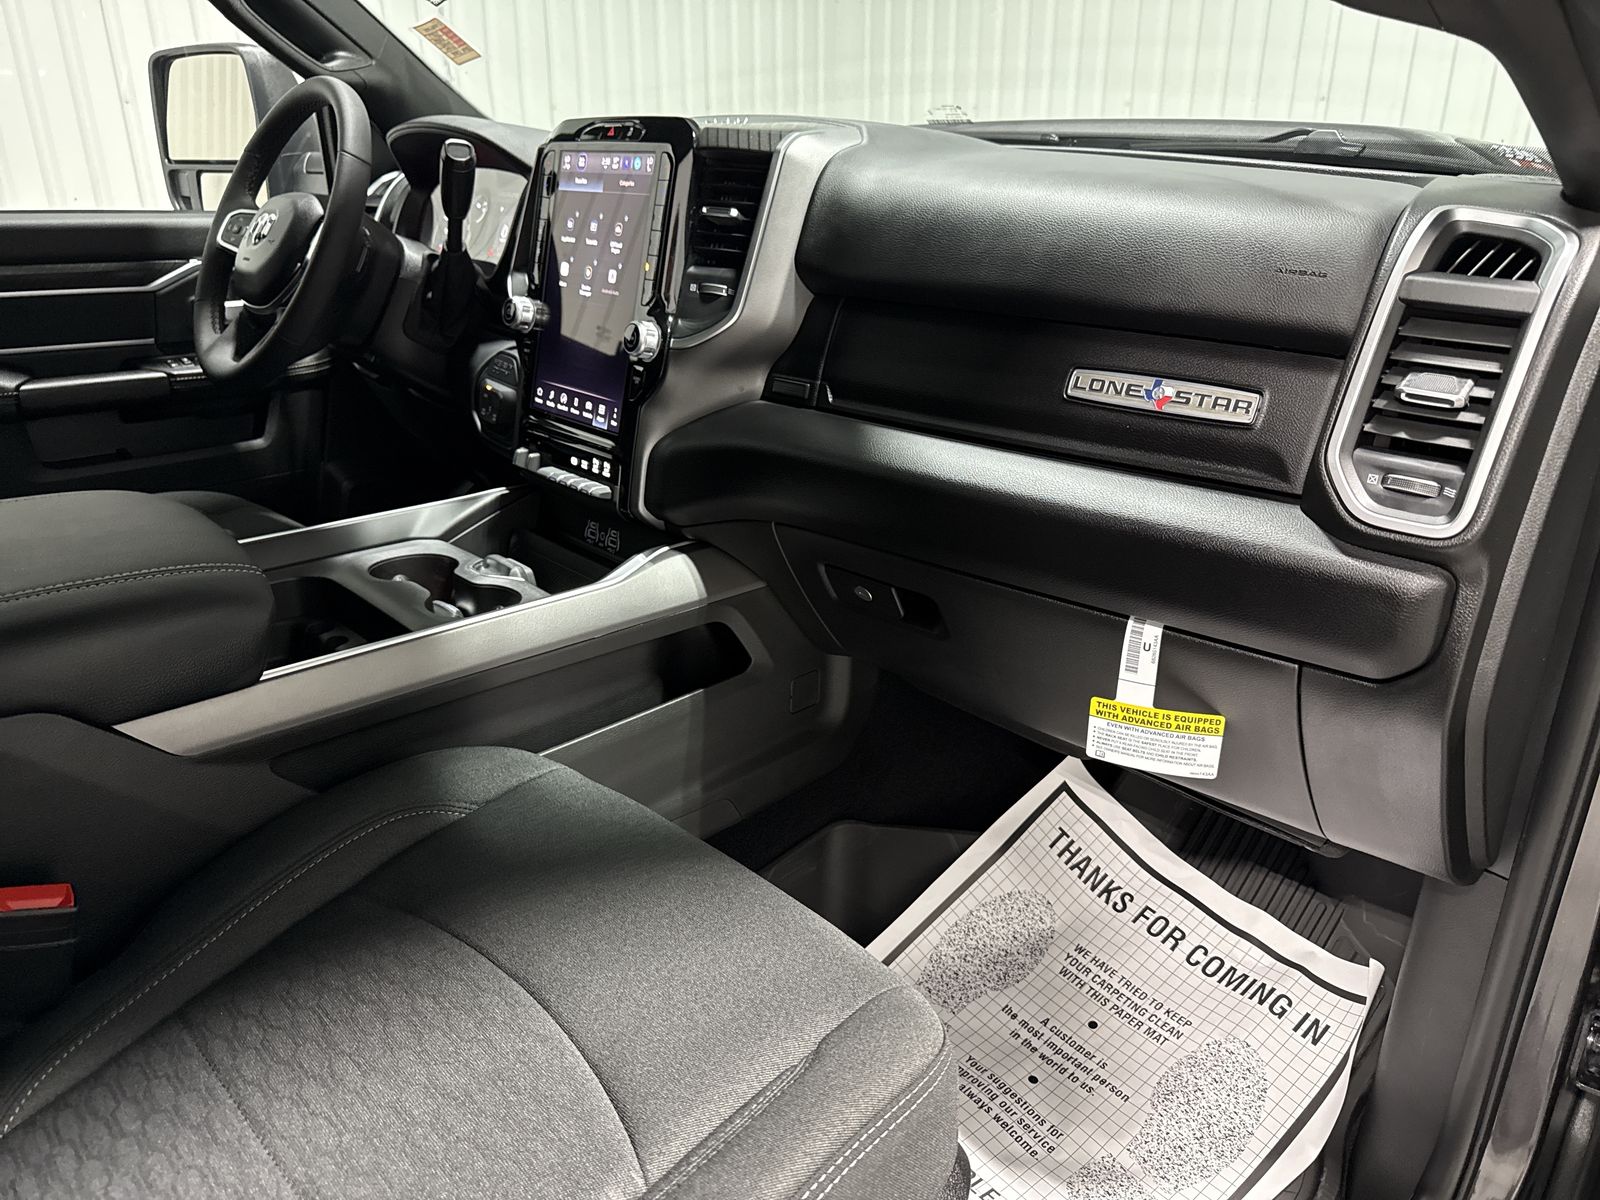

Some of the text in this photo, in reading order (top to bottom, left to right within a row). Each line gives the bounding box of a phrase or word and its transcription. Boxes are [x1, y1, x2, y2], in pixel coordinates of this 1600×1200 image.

[1275, 267, 1328, 279] AIRBAG
[1072, 375, 1253, 415] LONE STAR
[1143, 642, 1151, 651] U
[1095, 709, 1220, 734] WITH ADVANCED AIR BAGS
[1096, 701, 1221, 726] THIS VEHICLE IS EQUIPPED
[1107, 722, 1123, 730] EVEN
[1124, 725, 1139, 733] WITH
[1140, 728, 1174, 738] ADVANCED
[1187, 734, 1205, 742] BAGS
[1048, 827, 1331, 1047] THANKS FOR COMING IN
[1058, 966, 1170, 1047] WITH THIS PAPER MAT
[1063, 952, 1184, 1040] YOUR CARPETING CLEAN
[1073, 943, 1193, 1029] WE HAVE TRIED TO KEEP
[1001, 1004, 1130, 1103] the most important person
[1009, 1028, 1096, 1097] in the world to us.
[1040, 1017, 1108, 1070] A customer is
[958, 1065, 1056, 1154] mproving our service
[958, 1083, 1039, 1161] always welcome.
[964, 1055, 1065, 1141] Your suggestions for
